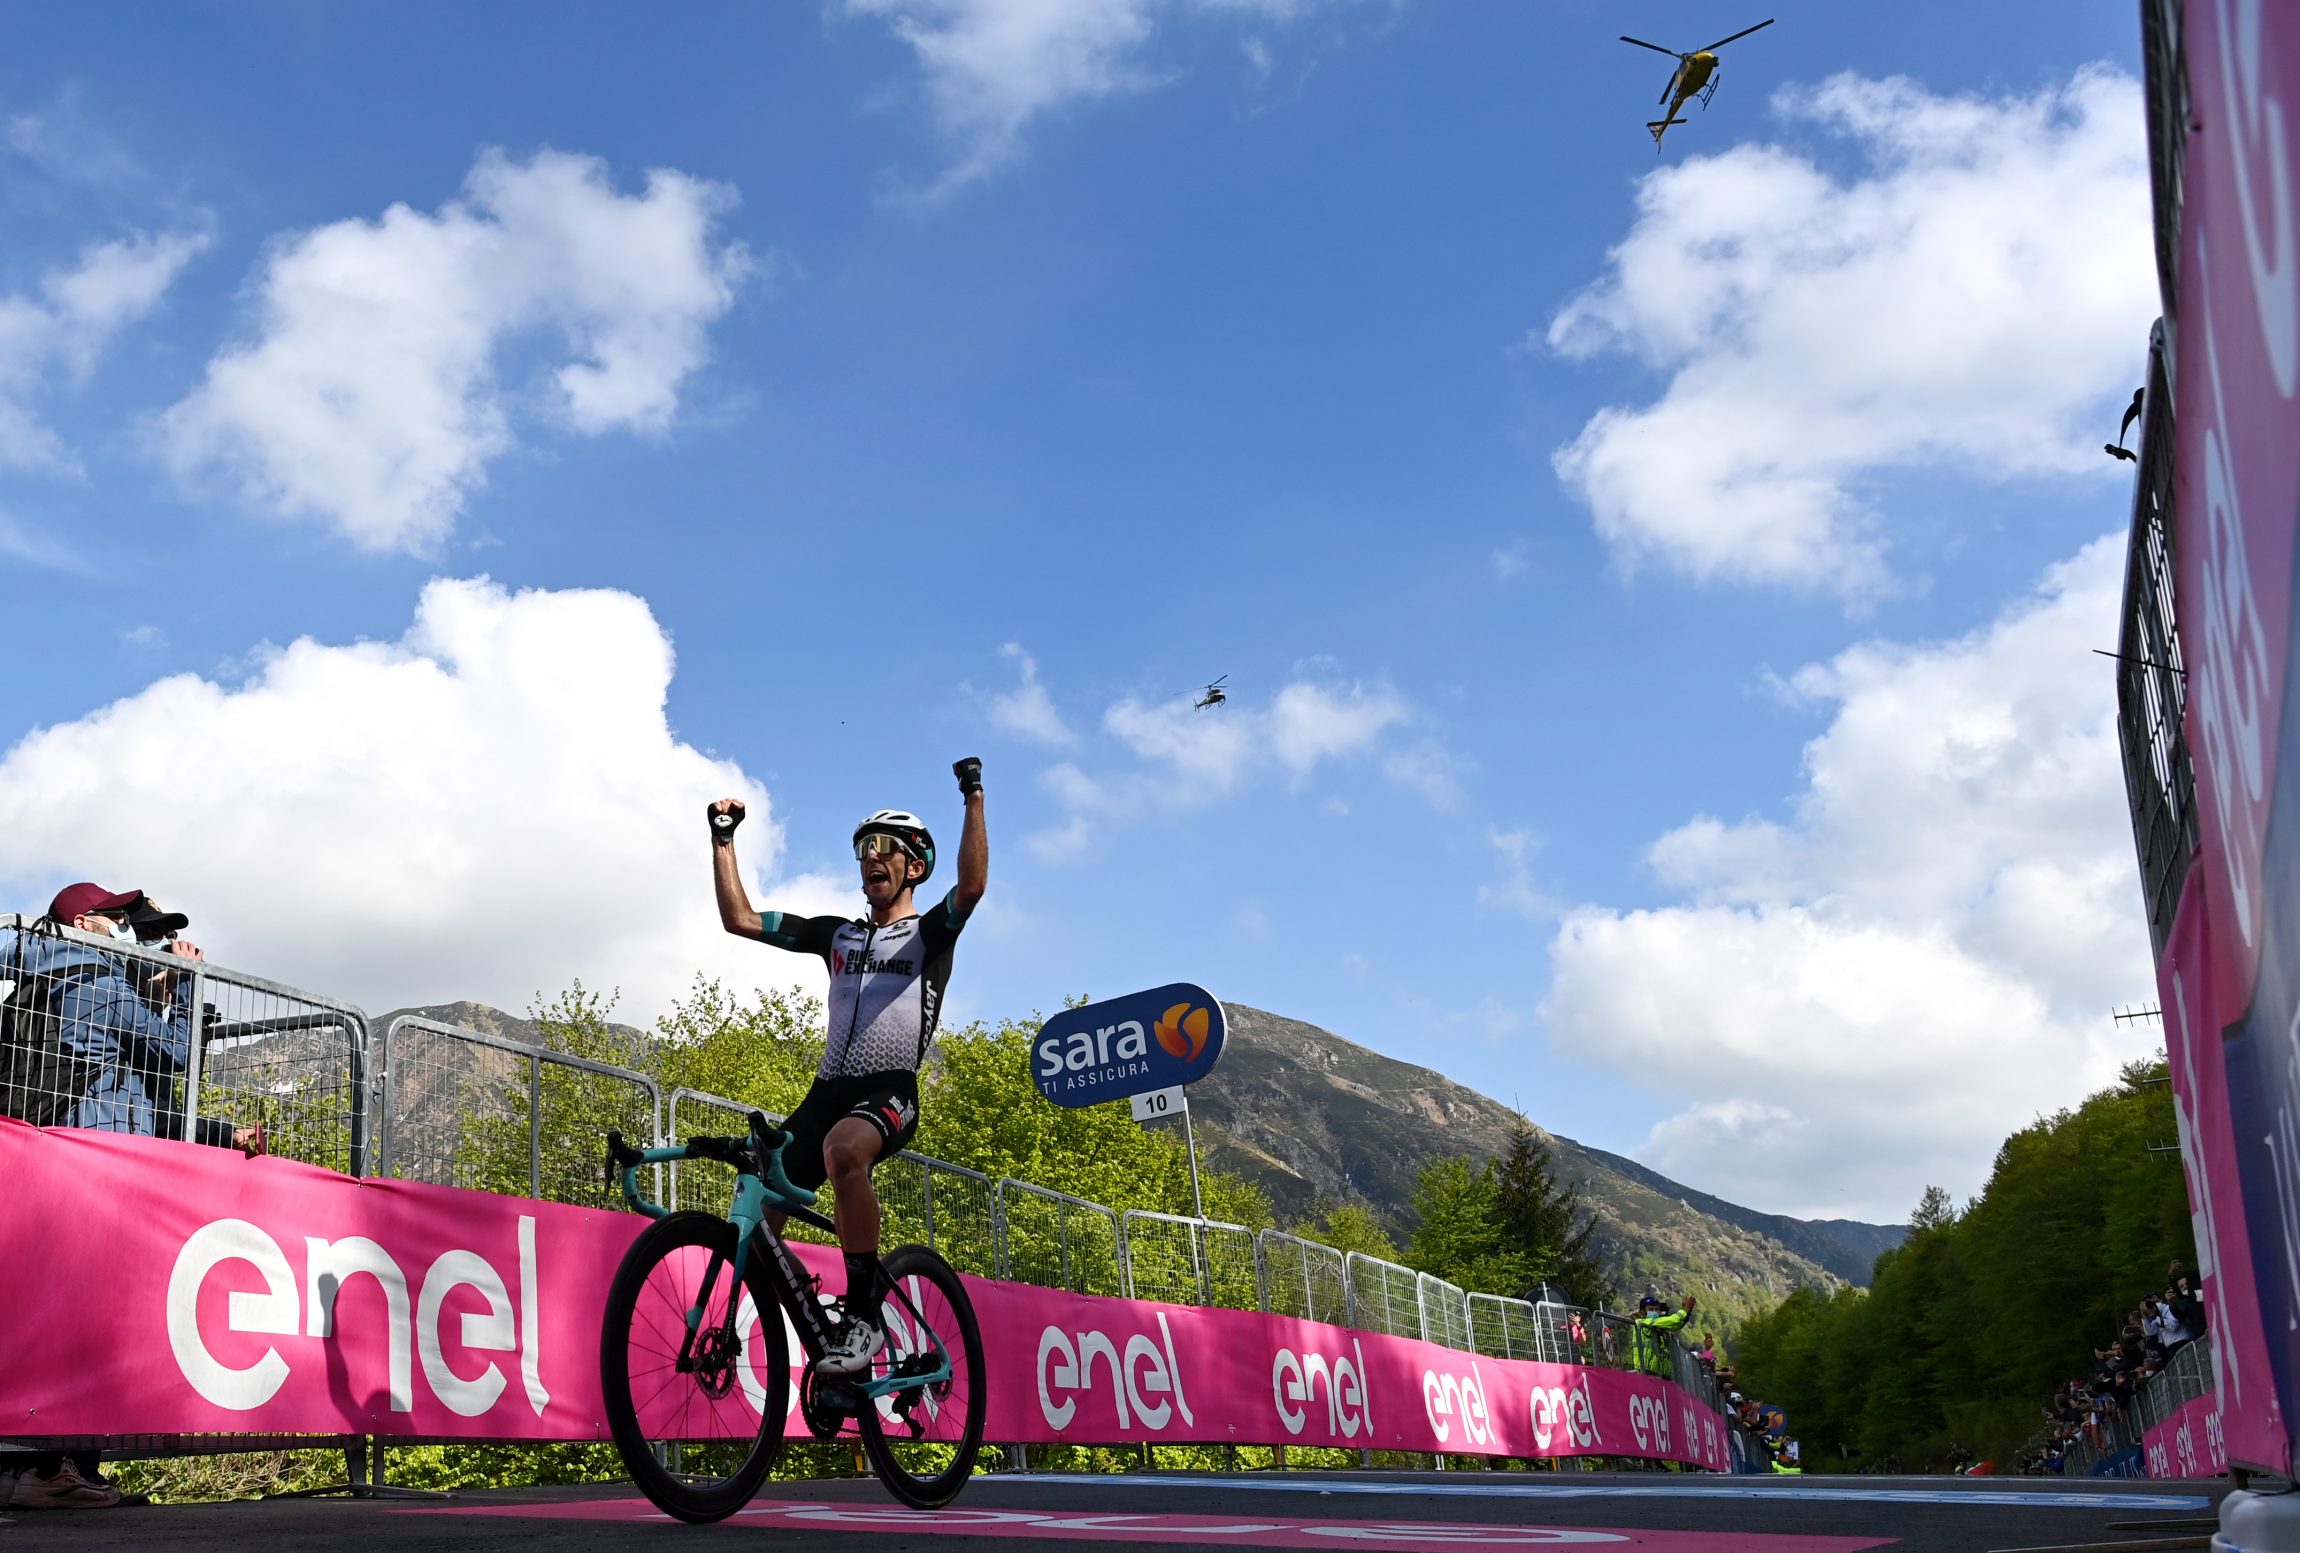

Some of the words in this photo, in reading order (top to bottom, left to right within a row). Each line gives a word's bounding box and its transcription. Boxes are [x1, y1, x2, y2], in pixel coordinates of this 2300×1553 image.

[845, 959, 914, 976] EXCHANGE
[922, 979, 938, 1049] Jayco
[1039, 1020, 1147, 1077] sara
[1042, 1081, 1057, 1095] TI
[1067, 1060, 1150, 1090] ASSICURA
[1145, 1094, 1167, 1114] 10
[166, 1215, 550, 1417] enel
[1037, 1311, 1194, 1431] enel
[1272, 1337, 1374, 1439] enel
[1423, 1360, 1496, 1446] enel
[1530, 1372, 1603, 1450] enel
[1629, 1386, 1671, 1453] enel
